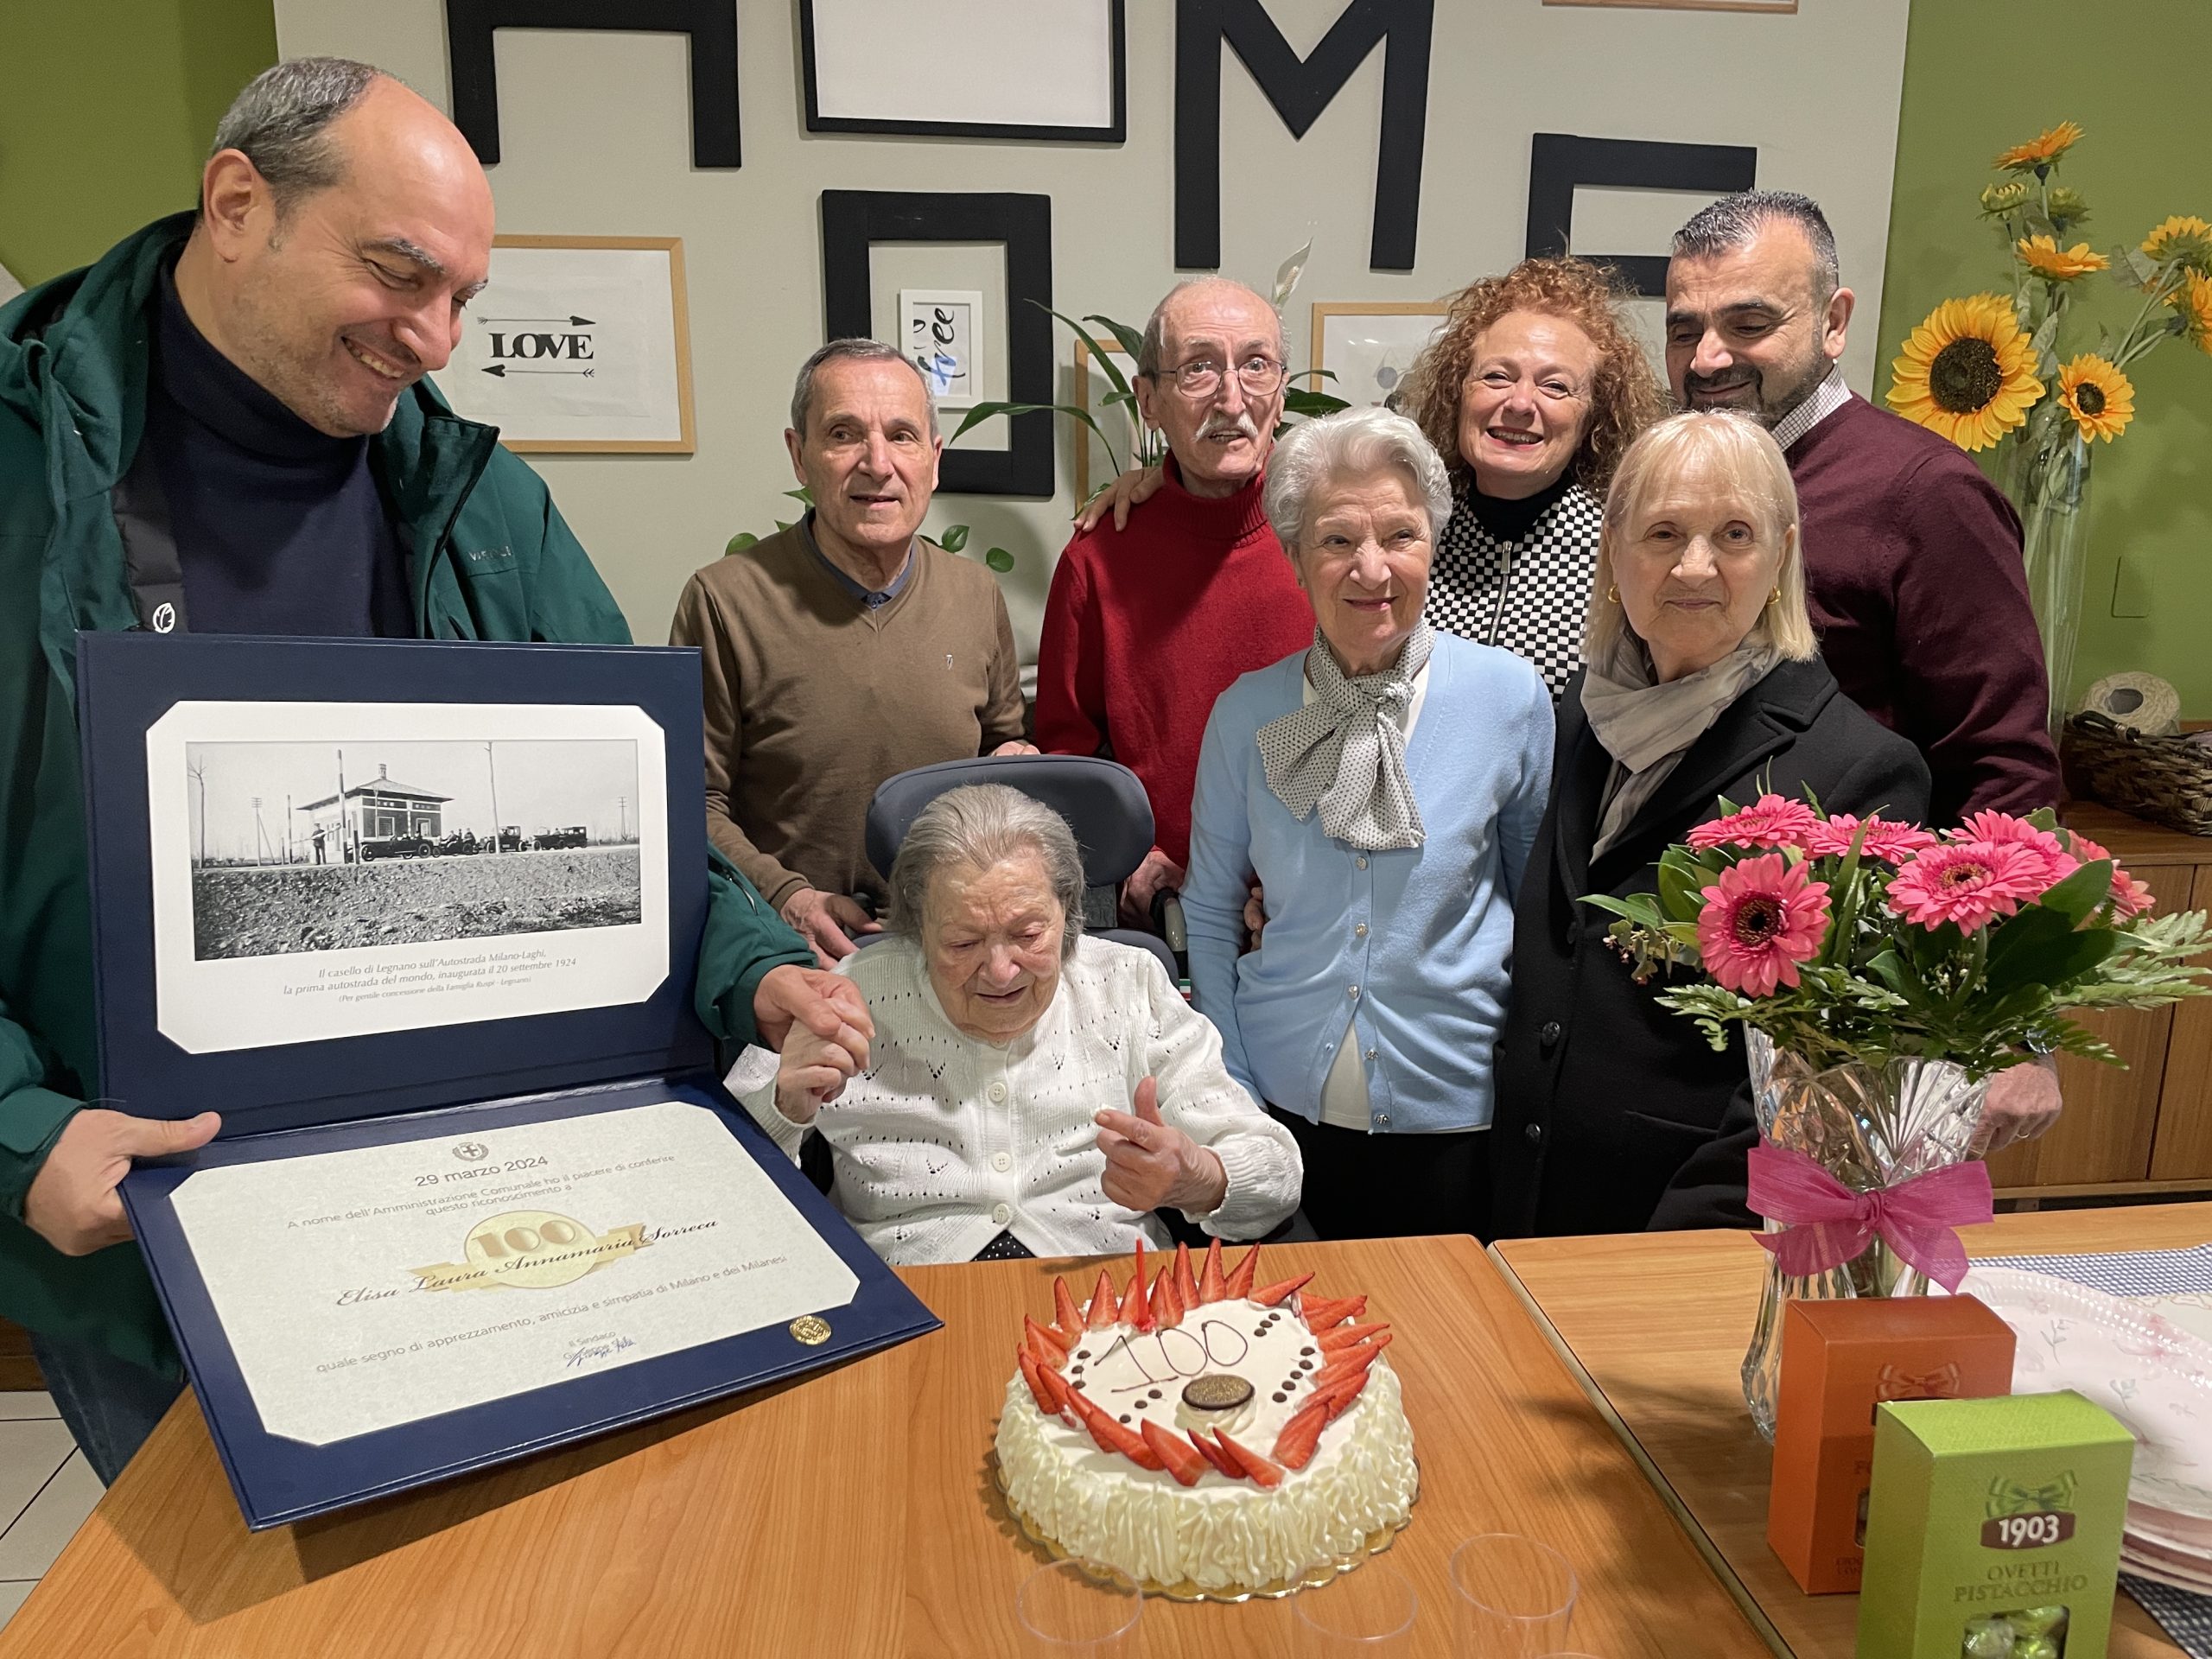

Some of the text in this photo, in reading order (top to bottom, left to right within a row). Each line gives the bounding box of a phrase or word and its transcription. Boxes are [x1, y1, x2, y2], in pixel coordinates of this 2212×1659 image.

[488, 333, 594, 359] LOVE
[918, 308, 966, 386] free
[283, 958, 576, 995] la prima autostrada del mondo, inaugurata il 20 settembre 1924
[319, 969, 325, 978] Il
[327, 966, 361, 976] casello
[364, 965, 373, 974] di
[377, 963, 416, 975] Legnano
[489, 950, 546, 962] Milano-Laghi,
[414, 1156, 549, 1187] 29 marzo 2024
[287, 1220, 299, 1230] A
[302, 1213, 340, 1226] nome
[345, 1192, 477, 1220] dell'Amministrazione
[480, 1180, 542, 1197] Comunale
[543, 1175, 560, 1187] ho
[573, 1166, 612, 1181] piacere
[615, 1162, 626, 1172] di
[628, 1155, 675, 1169] conferire
[426, 1201, 468, 1217] questo
[472, 1186, 562, 1208] riconoscimento
[471, 1220, 575, 1258] 100
[336, 1219, 718, 1306] Elisa Laura Annamaria Sorreca
[316, 1357, 358, 1374] quale
[361, 1347, 406, 1363] segno
[410, 1343, 423, 1352] di
[428, 1318, 536, 1350] apprezzamento,
[539, 1305, 589, 1322] amicizia
[592, 1300, 600, 1309] e
[602, 1288, 654, 1307] simpatia
[657, 1284, 668, 1294] di
[669, 1274, 710, 1290] Milano
[723, 1266, 740, 1276] dei
[741, 1255, 788, 1272] Milanesi
[1094, 1319, 1249, 1393] 100
[1998, 1514, 2060, 1548] 1903
[1987, 1560, 2059, 1580] OVETTI
[1954, 1573, 2088, 1603] PISTACCHIO
